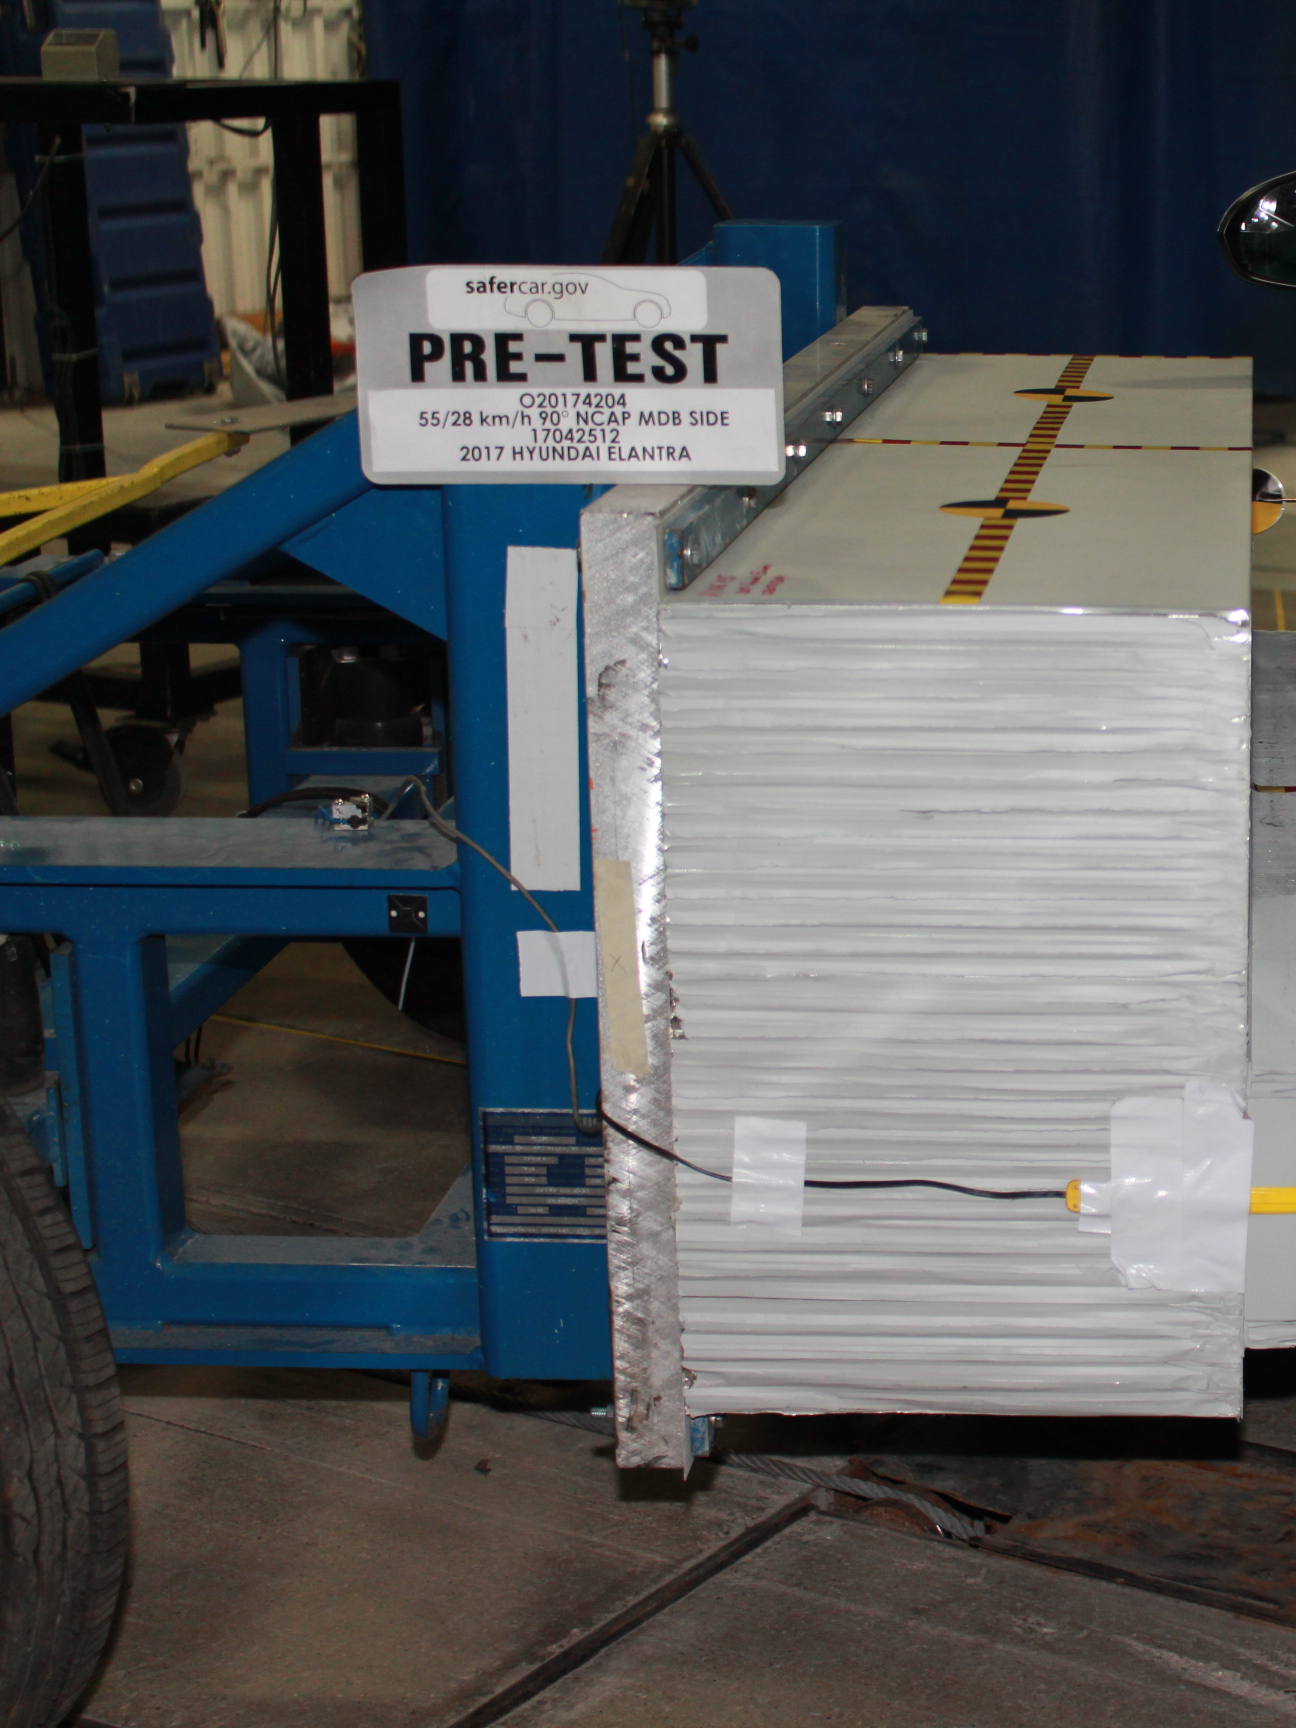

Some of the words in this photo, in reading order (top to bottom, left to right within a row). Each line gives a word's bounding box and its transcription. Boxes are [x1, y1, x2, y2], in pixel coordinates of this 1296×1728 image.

[465, 275, 588, 300] safercar.gov
[408, 332, 729, 385] PRE-TEST
[419, 410, 473, 429] 55/28
[479, 410, 532, 429] km/h
[576, 410, 631, 427] NCAP
[638, 410, 682, 426] MDB
[689, 410, 729, 427] SIDE
[531, 428, 620, 444] 17042512
[460, 445, 505, 462] 2017
[512, 445, 600, 462] HYUNDAI
[607, 445, 691, 462] ELANTRA
